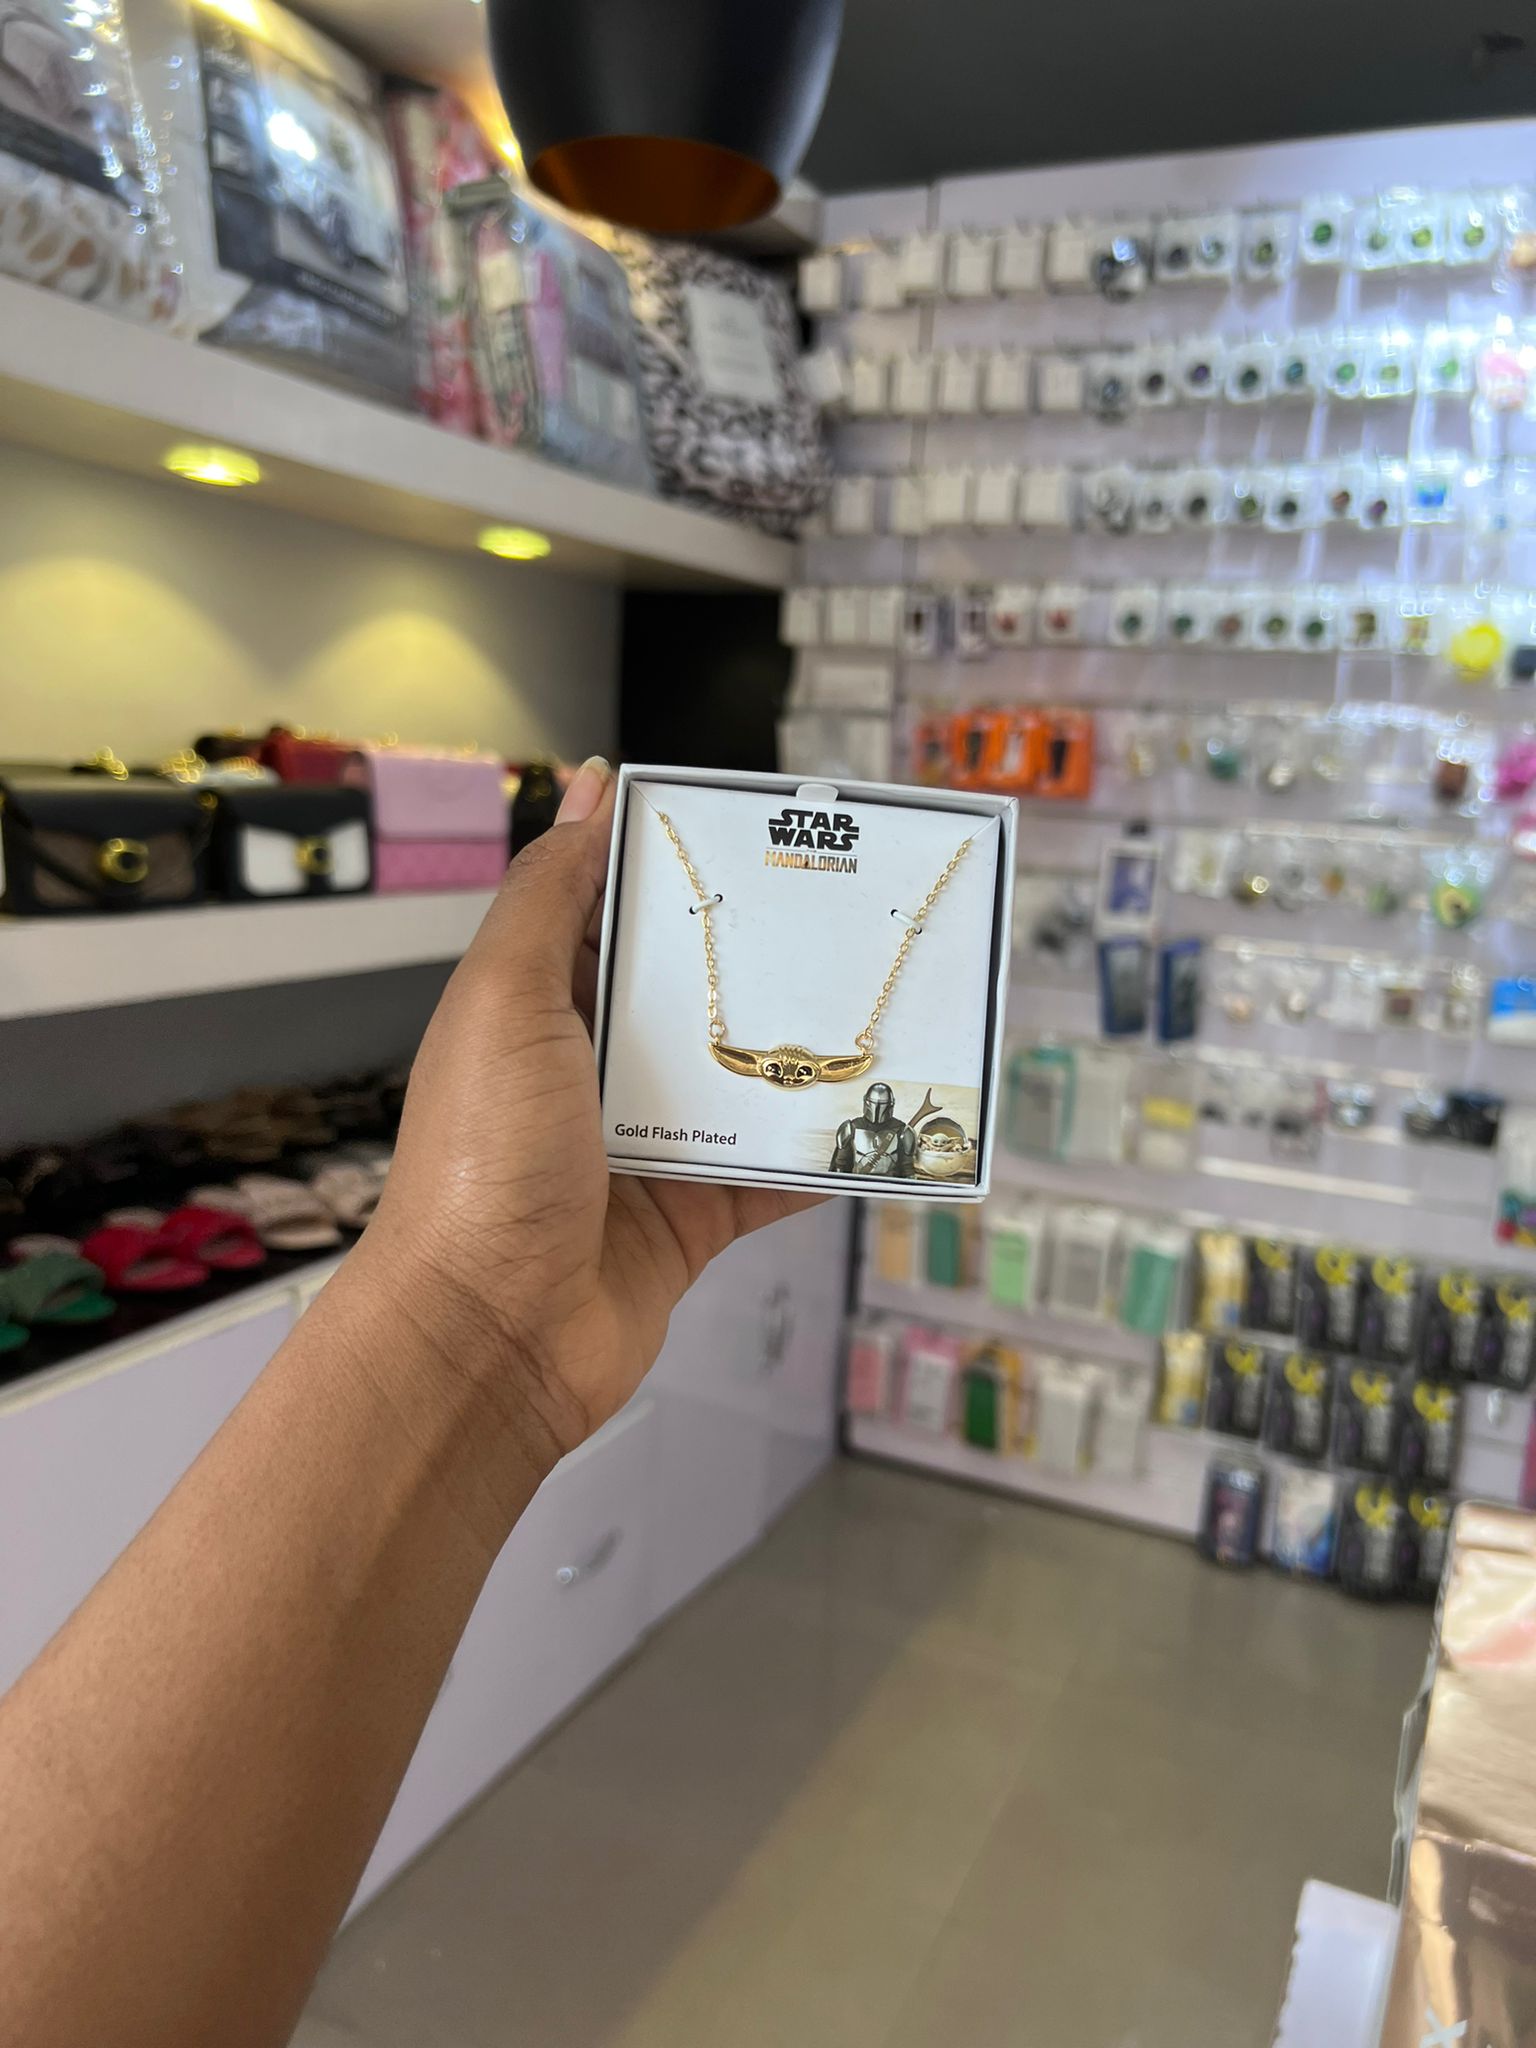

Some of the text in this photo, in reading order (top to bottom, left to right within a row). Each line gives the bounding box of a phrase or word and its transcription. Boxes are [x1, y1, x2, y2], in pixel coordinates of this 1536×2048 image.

[768, 809, 860, 833] STAR
[768, 826, 860, 851] WARS
[764, 850, 858, 874] MANDALORIAN
[614, 1123, 737, 1145] Gold Flash Plated
